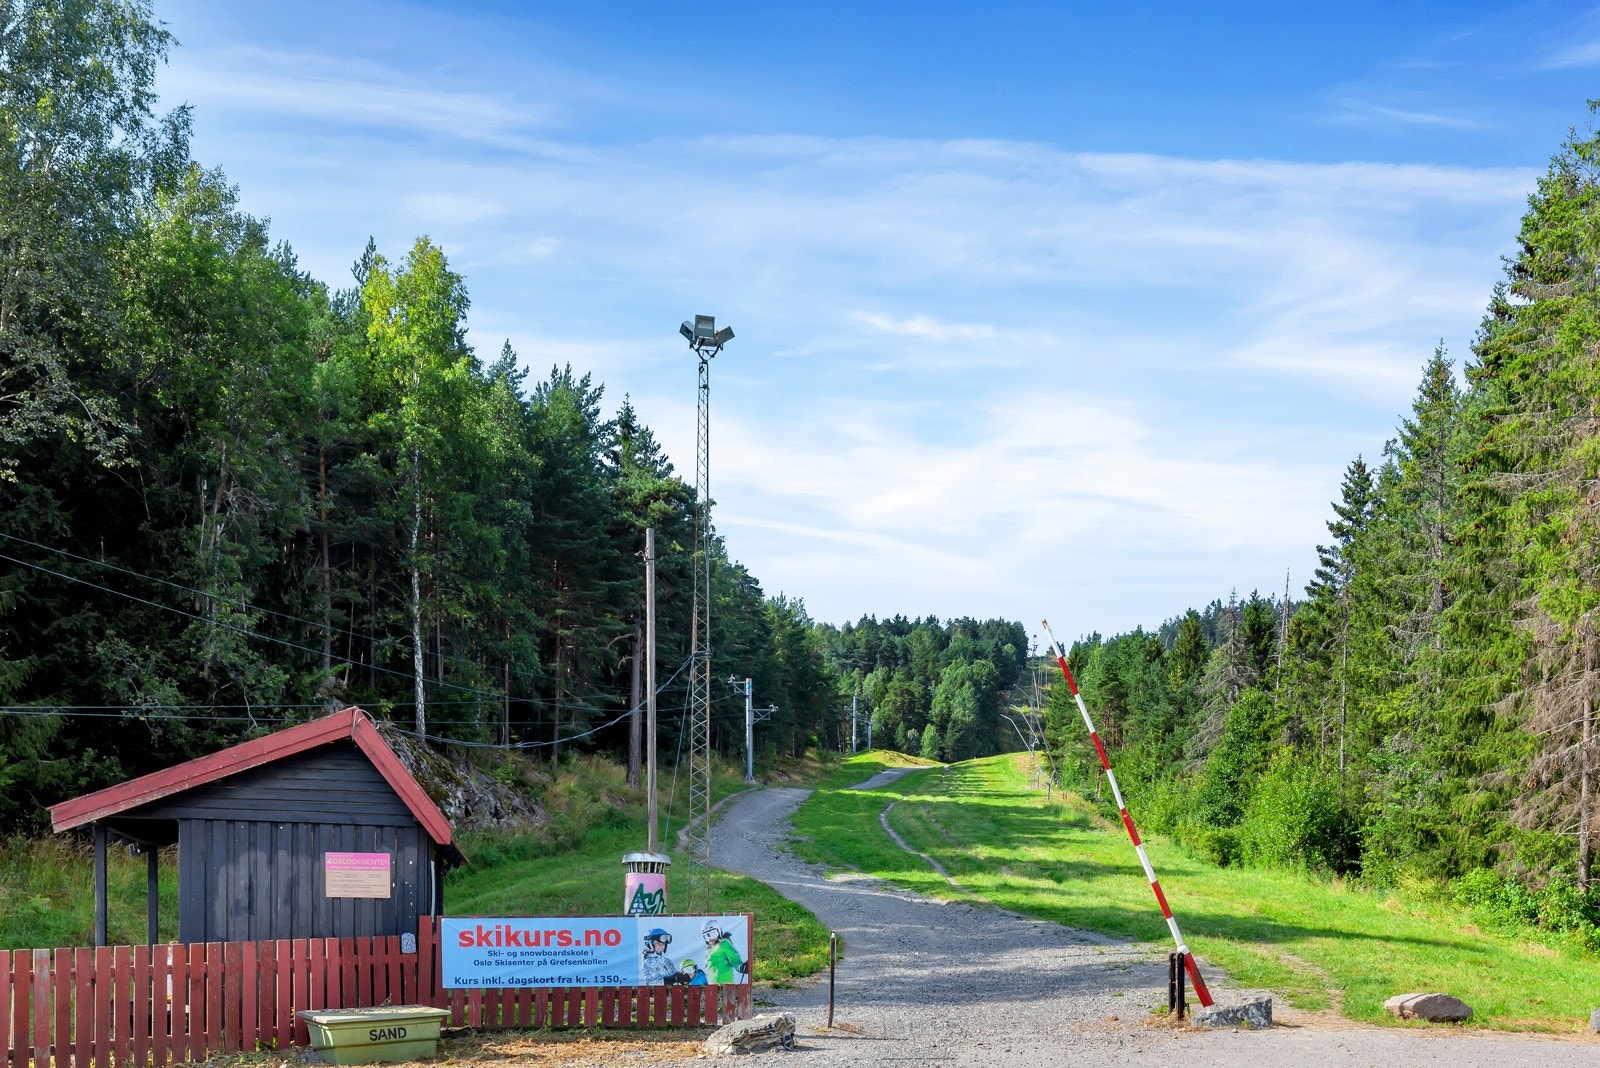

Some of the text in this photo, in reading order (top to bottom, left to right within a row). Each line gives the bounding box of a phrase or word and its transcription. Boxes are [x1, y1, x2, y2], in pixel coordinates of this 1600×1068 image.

[458, 924, 622, 947] skikurs.no
[487, 949, 505, 957] Ski-
[519, 949, 589, 958] snowboardskole
[473, 958, 608, 967] Oslo Skisenter på Grefsenkollen
[454, 975, 627, 987] Kurs inkl. dagskort fra kr. 1350,-
[369, 1027, 407, 1041] SAND
